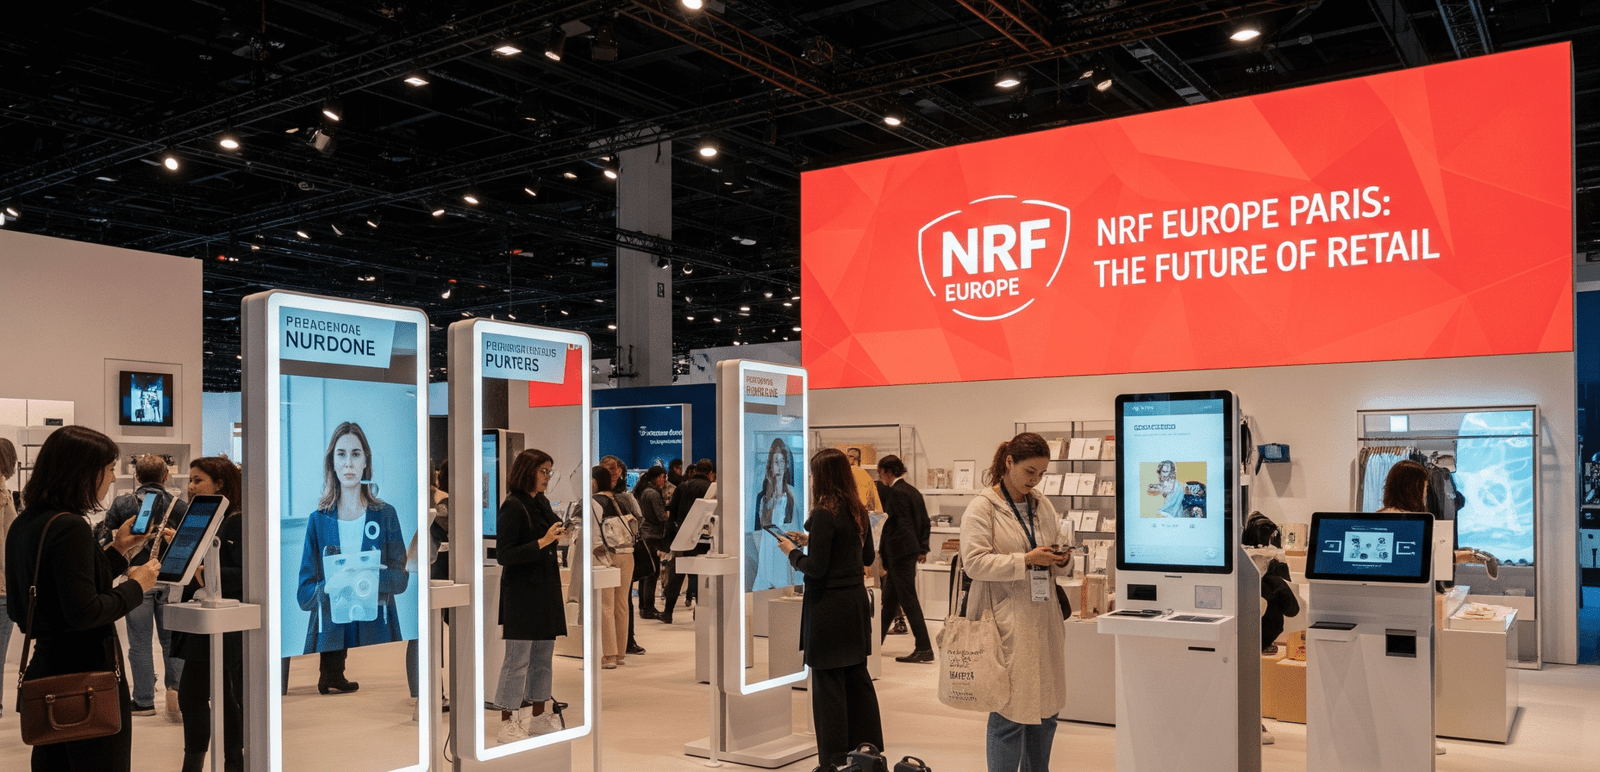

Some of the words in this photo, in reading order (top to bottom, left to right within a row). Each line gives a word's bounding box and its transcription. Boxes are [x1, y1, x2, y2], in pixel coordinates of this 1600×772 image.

[1097, 212, 1154, 247] NRF
[1162, 197, 1279, 240] EUROPE
[1290, 185, 1391, 227] PARIS:
[942, 218, 1051, 278] NRF
[1093, 255, 1147, 288] THE
[1155, 243, 1268, 283] FUTURE
[1276, 238, 1318, 272] OF
[1328, 228, 1441, 268] RETAIL
[945, 276, 1020, 302] EUROPE
[286, 330, 376, 356] NURDONE
